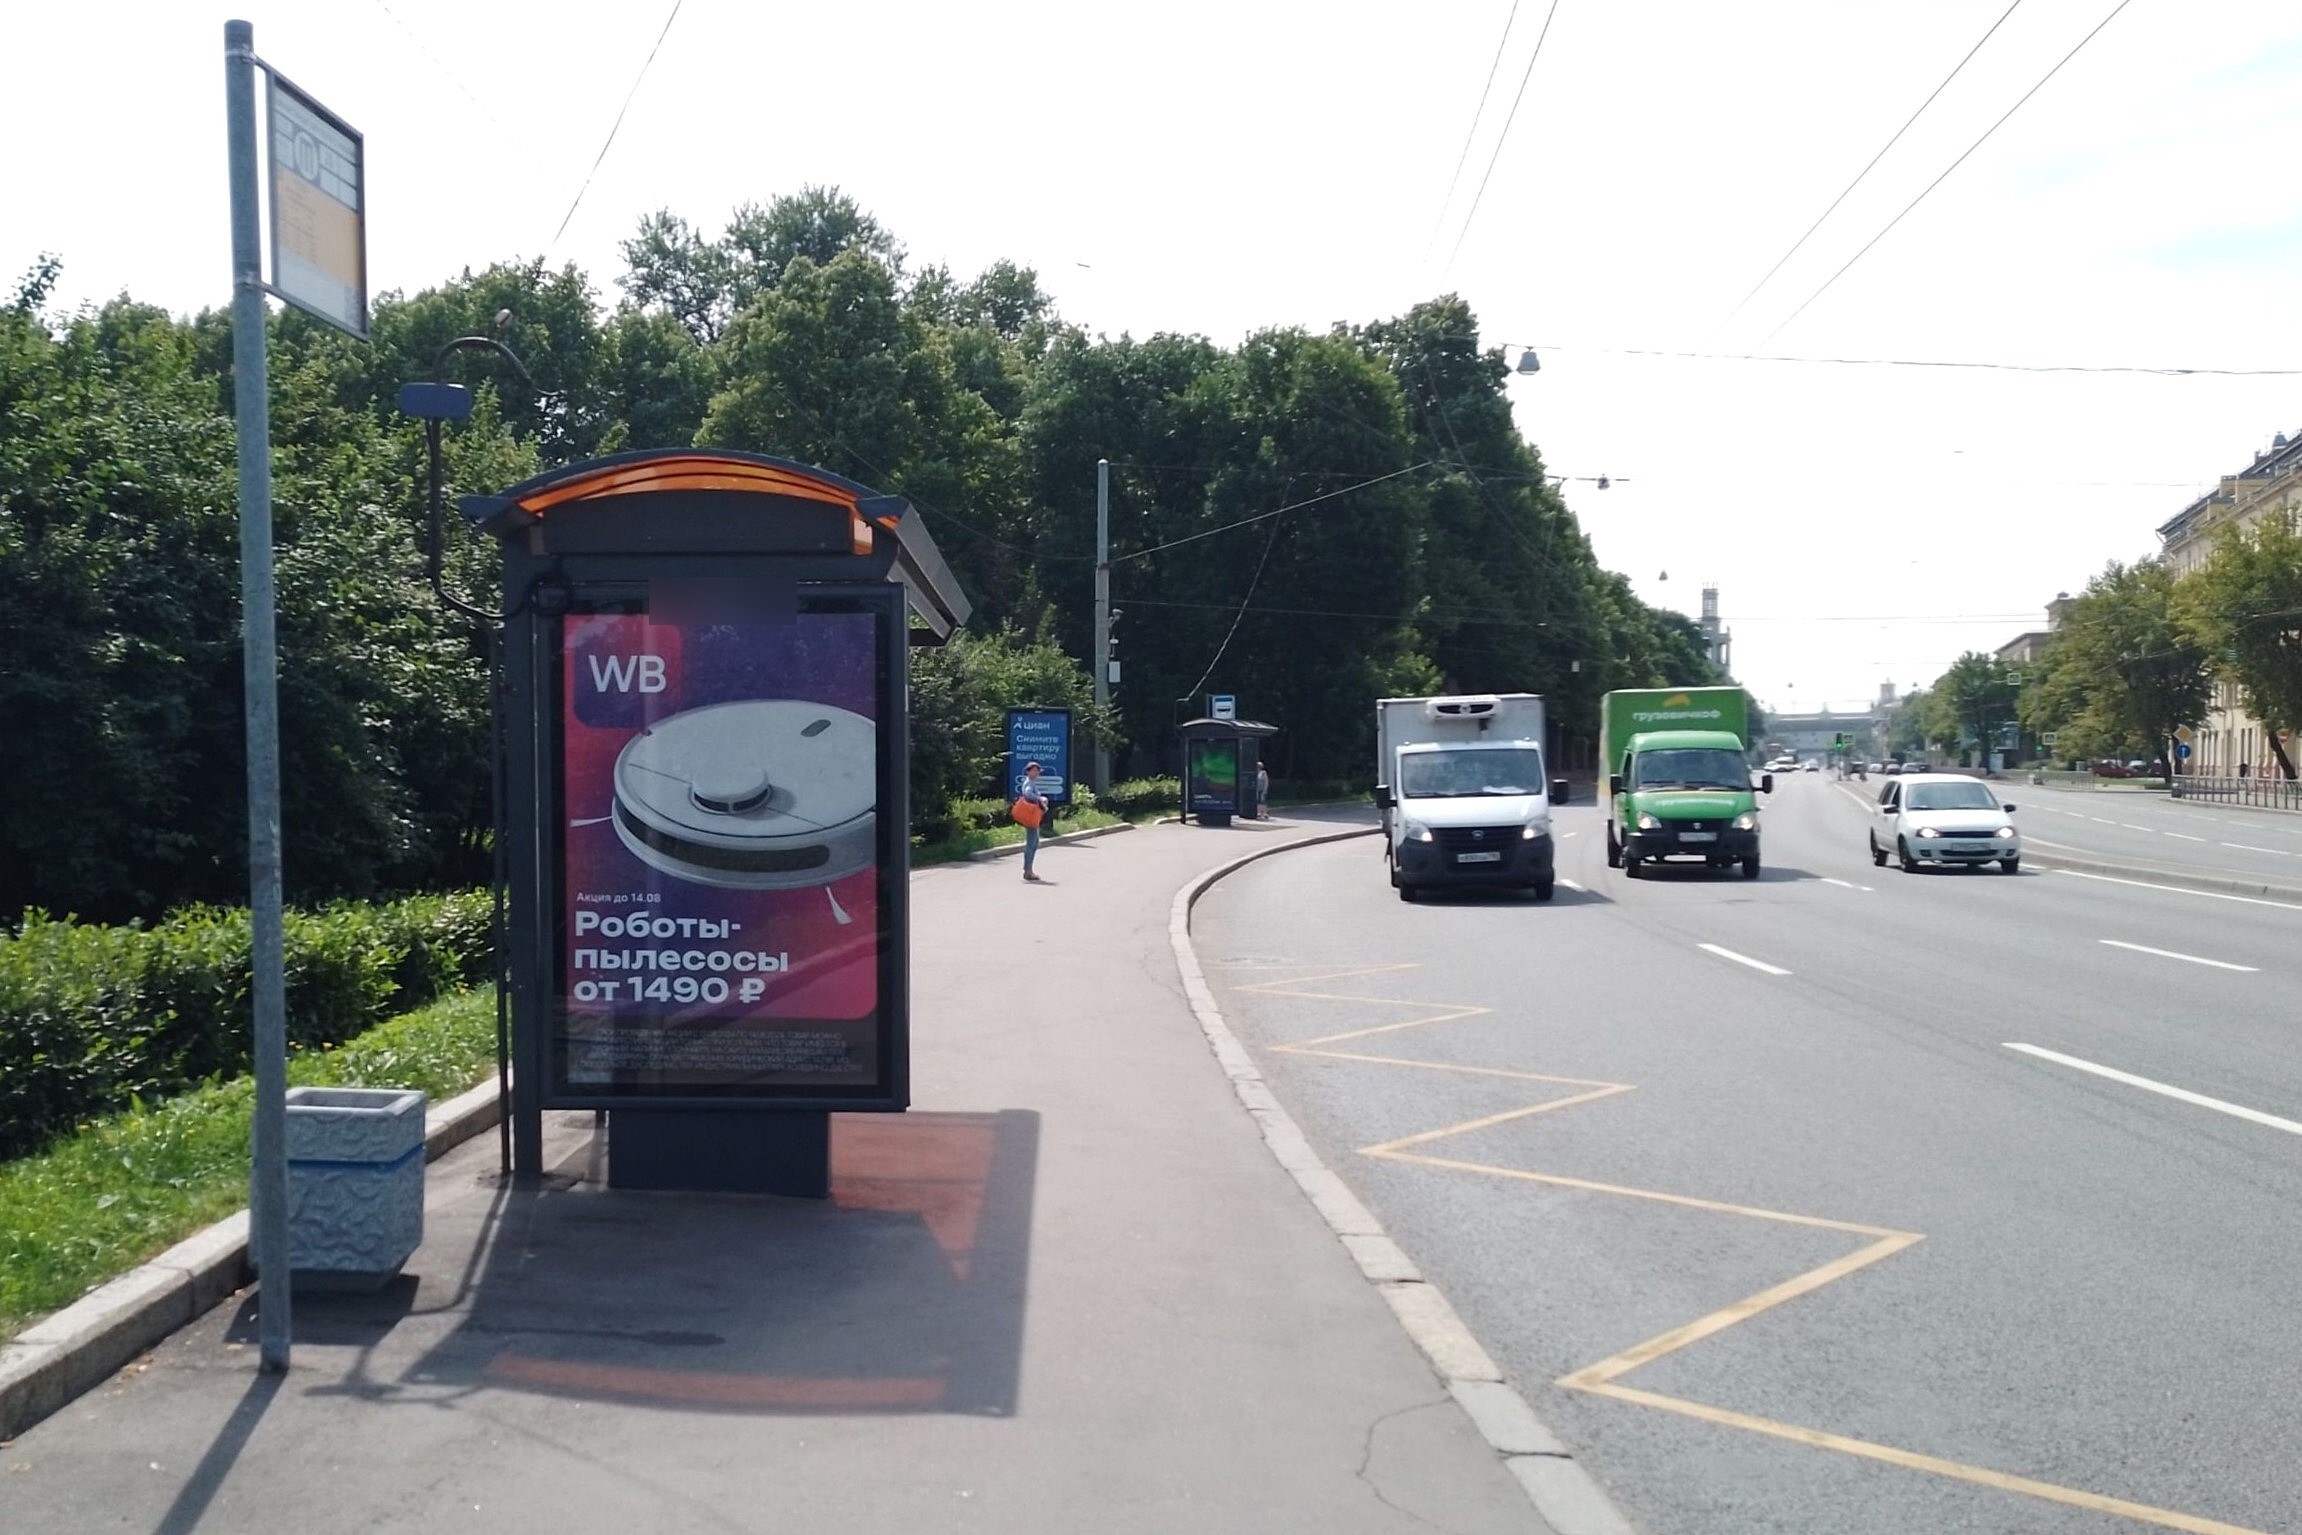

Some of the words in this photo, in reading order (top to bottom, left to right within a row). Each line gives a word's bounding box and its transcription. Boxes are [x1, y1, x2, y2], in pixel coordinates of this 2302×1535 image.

[588, 654, 667, 693] WB
[1016, 735, 1059, 743] Снимите
[1016, 745, 1060, 753] квартиру
[576, 892, 611, 903] Акция
[613, 893, 629, 904] до
[631, 893, 662, 903] 14.08
[575, 910, 742, 939] Роботы-
[574, 949, 789, 972] пылесосы
[573, 980, 621, 1002] от
[627, 976, 730, 1004] 1490
[738, 977, 766, 1004] ₽
